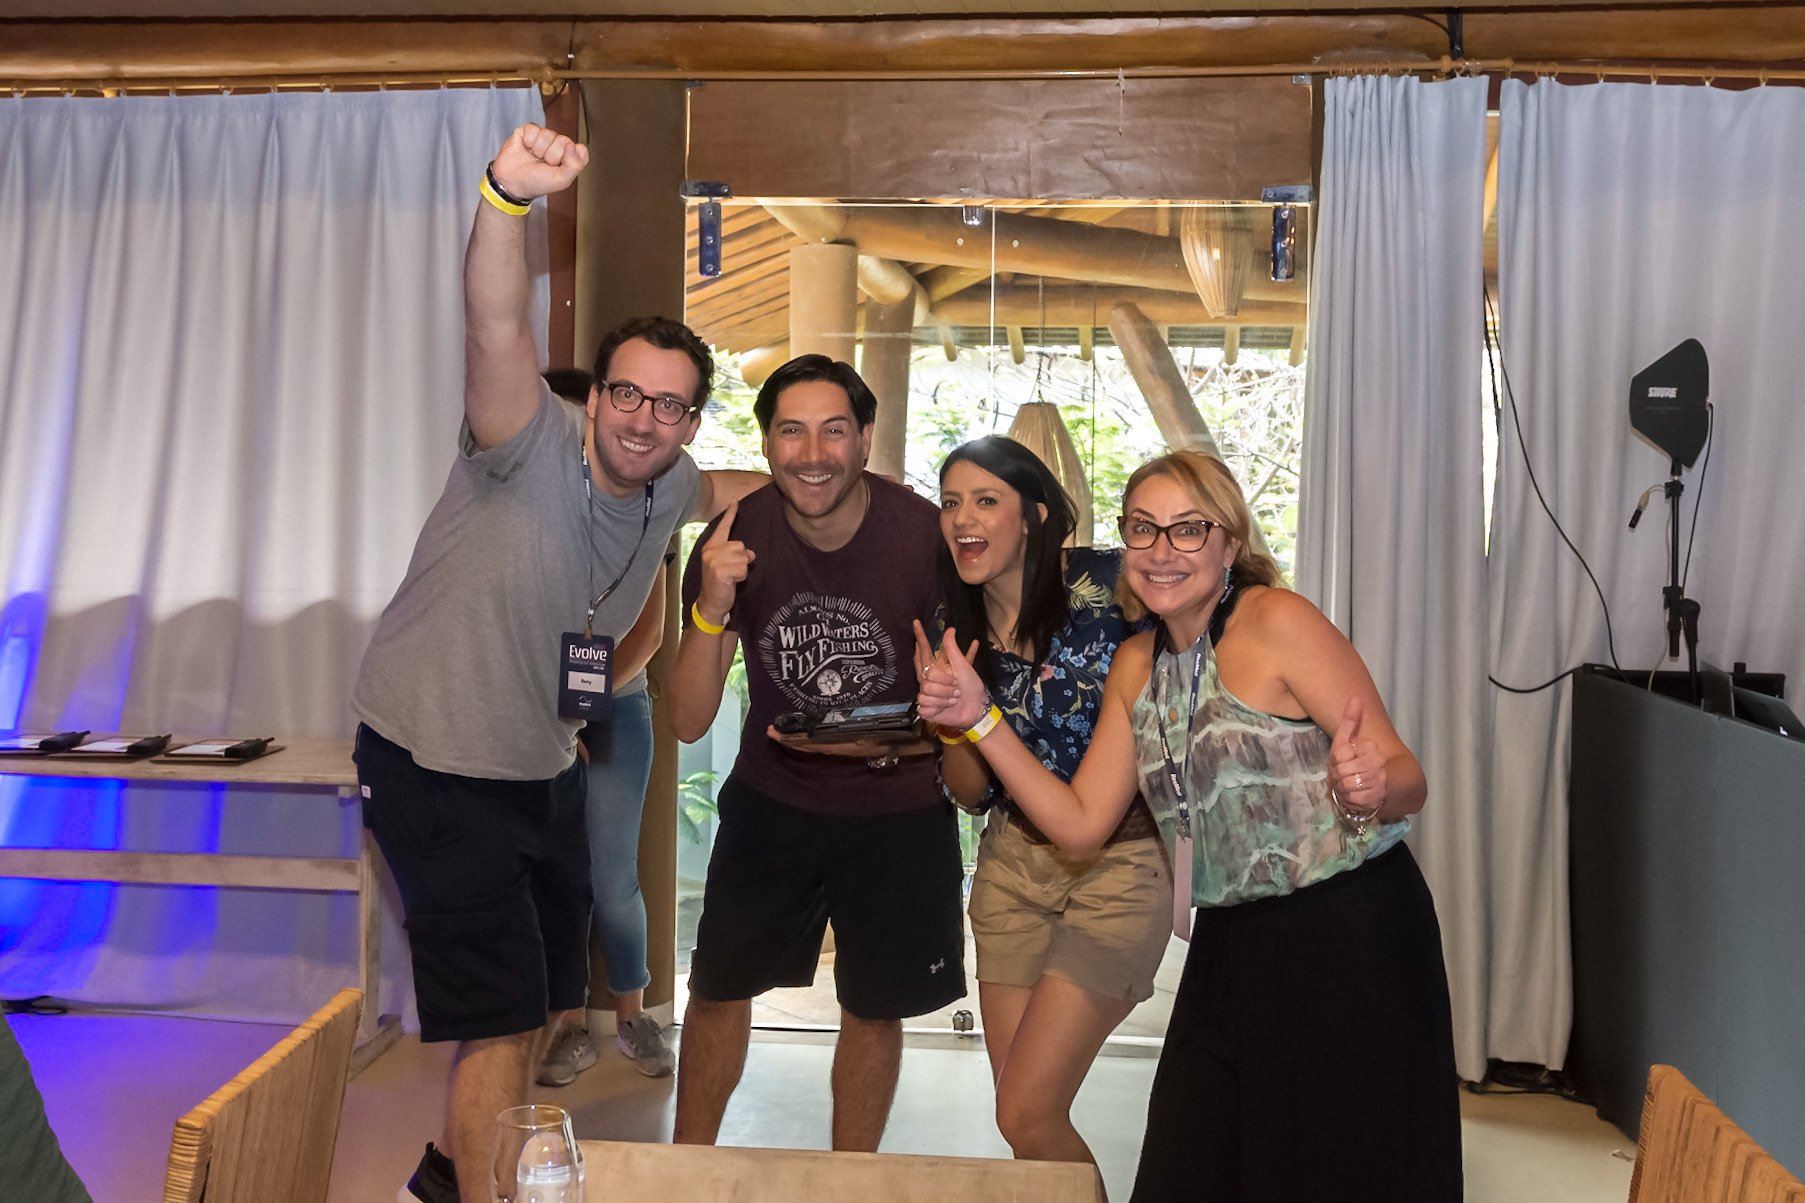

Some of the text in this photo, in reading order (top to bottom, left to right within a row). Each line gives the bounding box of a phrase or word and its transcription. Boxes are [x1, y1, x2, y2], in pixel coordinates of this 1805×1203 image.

[778, 624, 821, 649] WILD
[569, 644, 607, 662] Evolve
[778, 637, 876, 680] FLY FISHING
